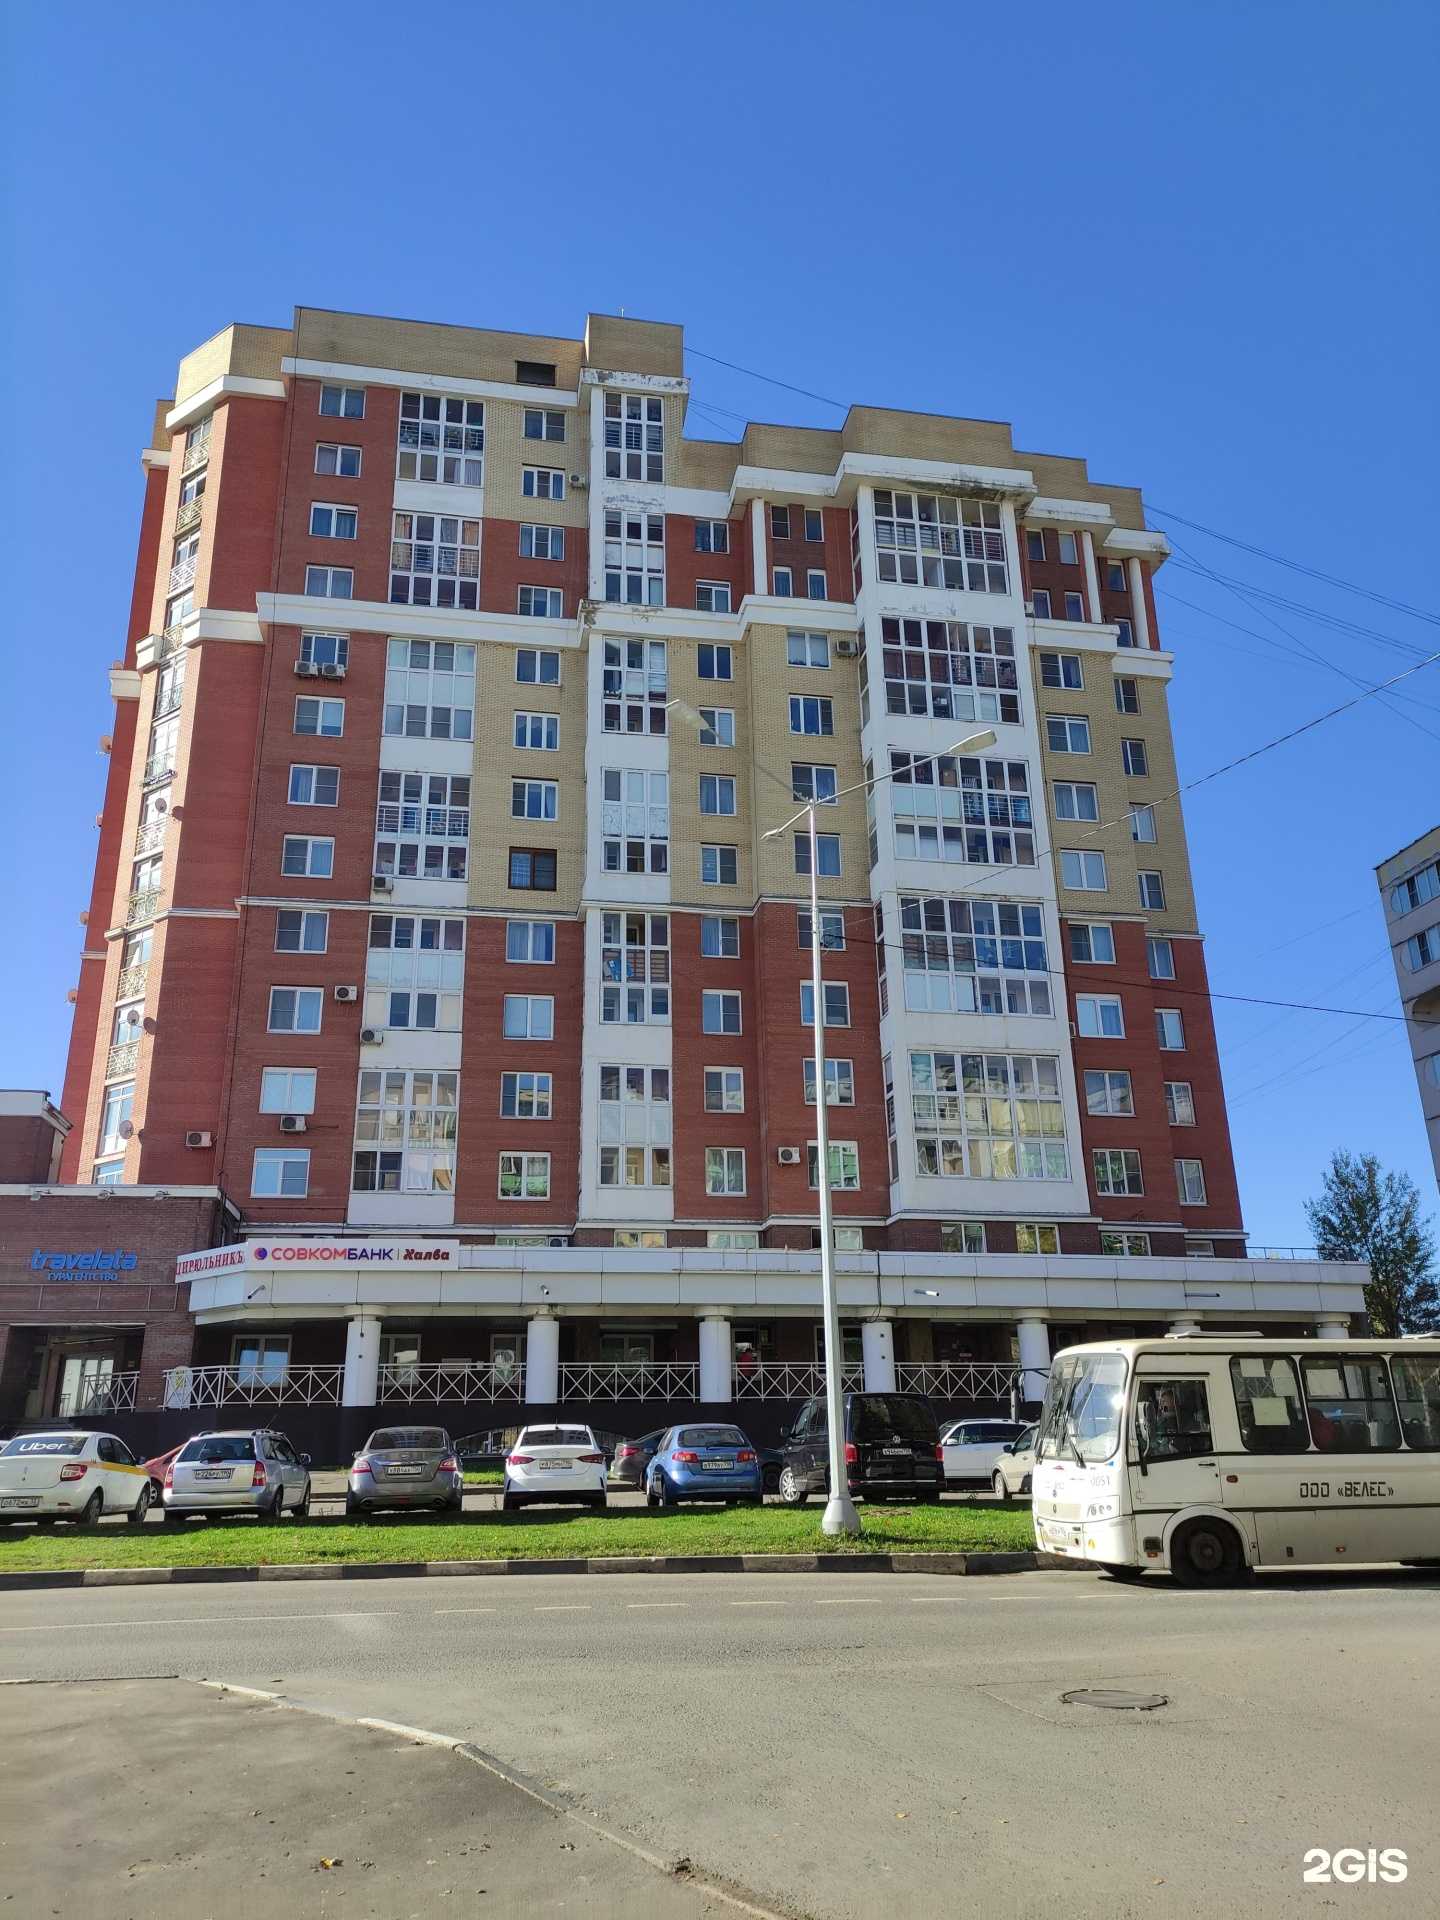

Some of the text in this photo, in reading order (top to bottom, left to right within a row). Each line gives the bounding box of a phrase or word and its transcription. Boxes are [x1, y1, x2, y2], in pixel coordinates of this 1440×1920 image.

[31, 1248, 139, 1270] travelata
[271, 1247, 450, 1262] СОВКОМБАНК Халва
[47, 1271, 119, 1281] ТУРАГЕНТСТВО
[1299, 1482, 1330, 1498] ООО
